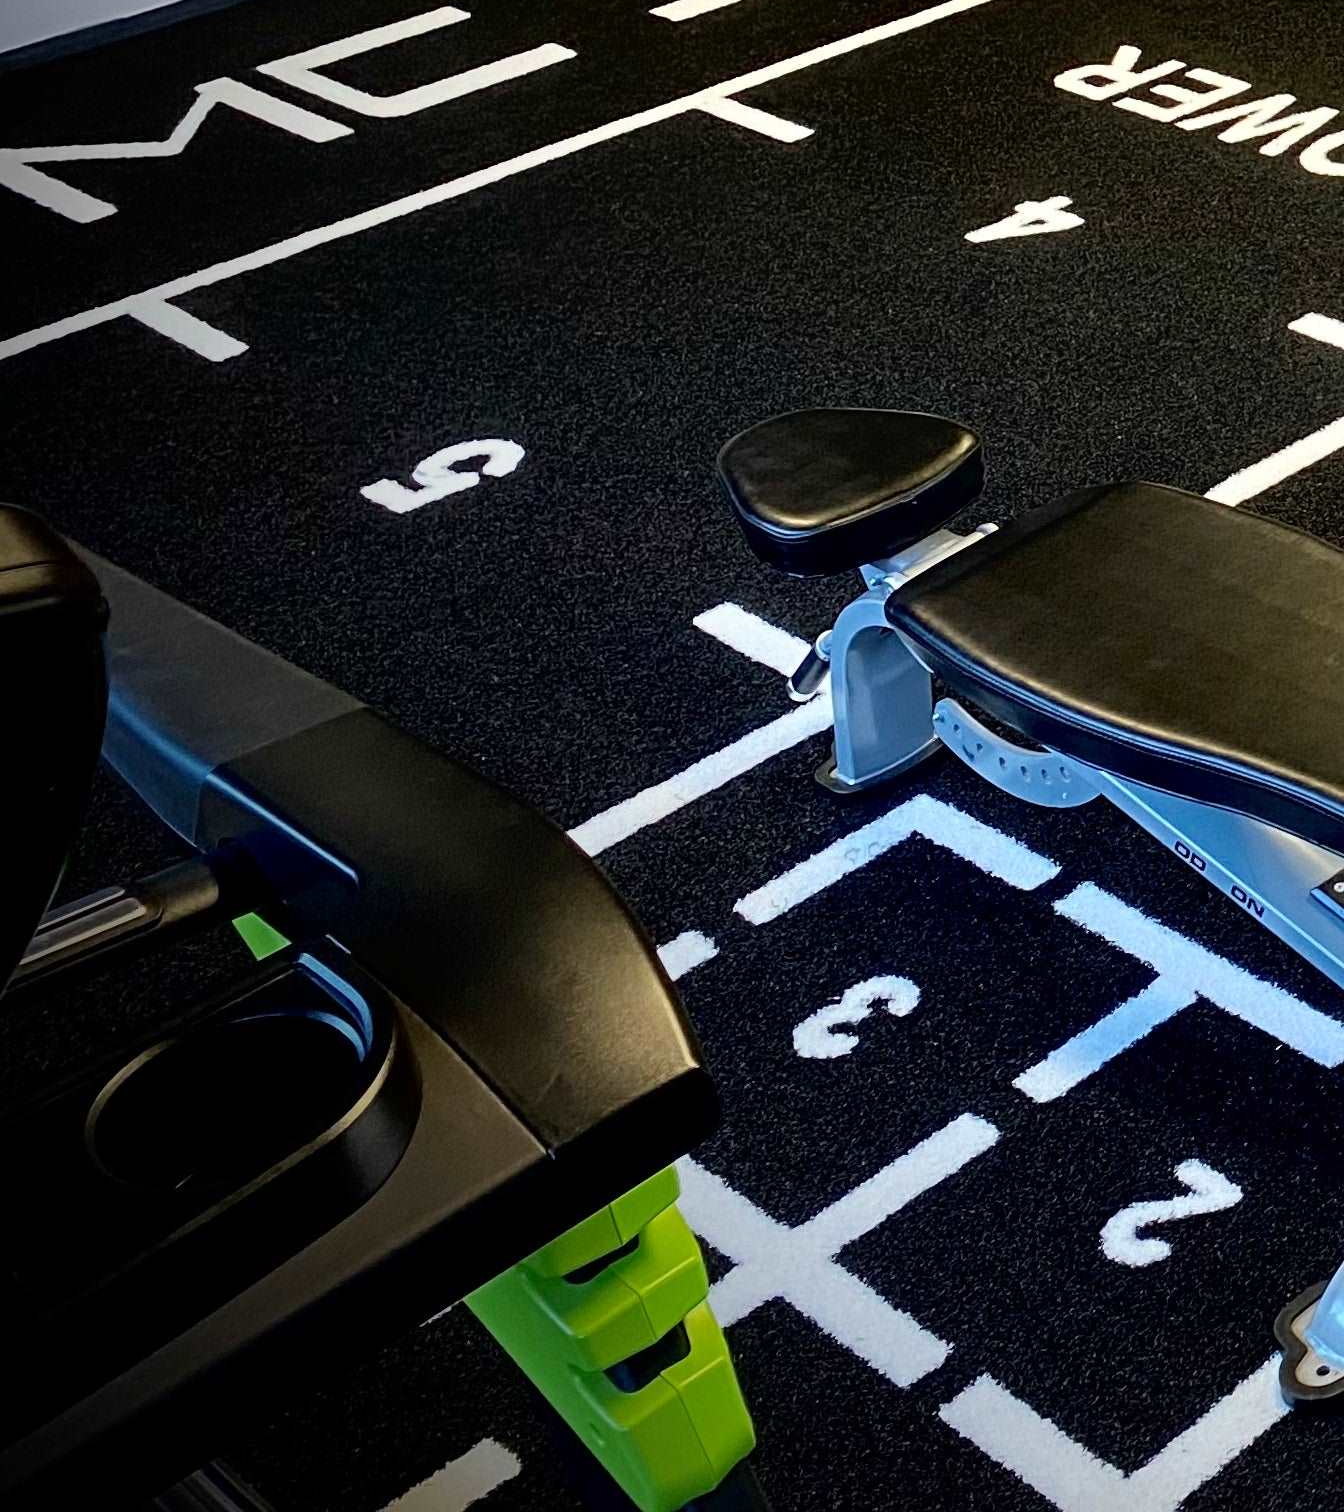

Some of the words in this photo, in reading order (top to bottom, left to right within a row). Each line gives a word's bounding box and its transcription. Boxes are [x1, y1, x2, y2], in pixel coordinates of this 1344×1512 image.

[0, 5, 578, 223] MC
[964, 194, 1086, 244] 4
[359, 438, 526, 514] 5
[792, 974, 921, 1060] 3
[1098, 1157, 1244, 1268] 2
